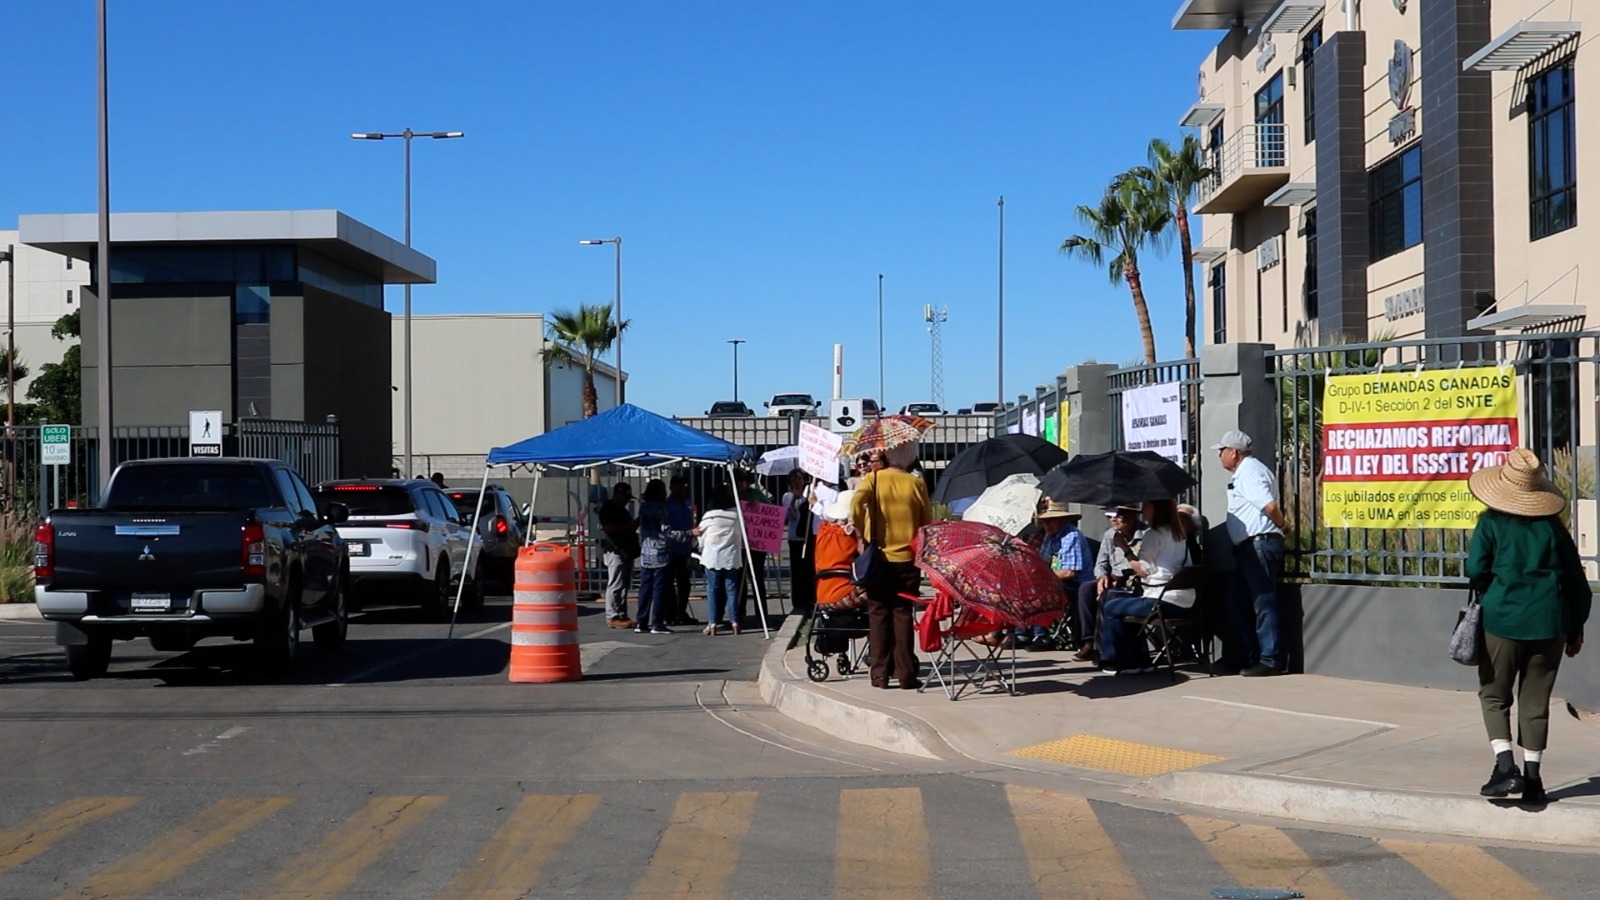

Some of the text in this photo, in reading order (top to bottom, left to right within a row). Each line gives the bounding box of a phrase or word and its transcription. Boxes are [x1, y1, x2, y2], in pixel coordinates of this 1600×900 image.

[1328, 384, 1361, 399] Grupo
[1363, 379, 1435, 395] DEMANDAS
[1339, 394, 1497, 414] D-IV-1 Sección 2 del SNTE.
[44, 434, 68, 443] UBER
[1328, 424, 1511, 450] RECHAZAMOS REFORMA
[44, 445, 56, 454] 10
[193, 445, 219, 455] VISITAS
[1324, 450, 1511, 476] A LA LEY DEL ISSSTE 200
[1325, 490, 1342, 503] Los
[1343, 489, 1396, 506] jubilados
[1398, 489, 1447, 506] exigimos
[1341, 507, 1354, 521] de
[1355, 507, 1366, 521] la
[1367, 507, 1395, 521] UMA
[1397, 509, 1411, 521] en
[1412, 507, 1432, 521] las
